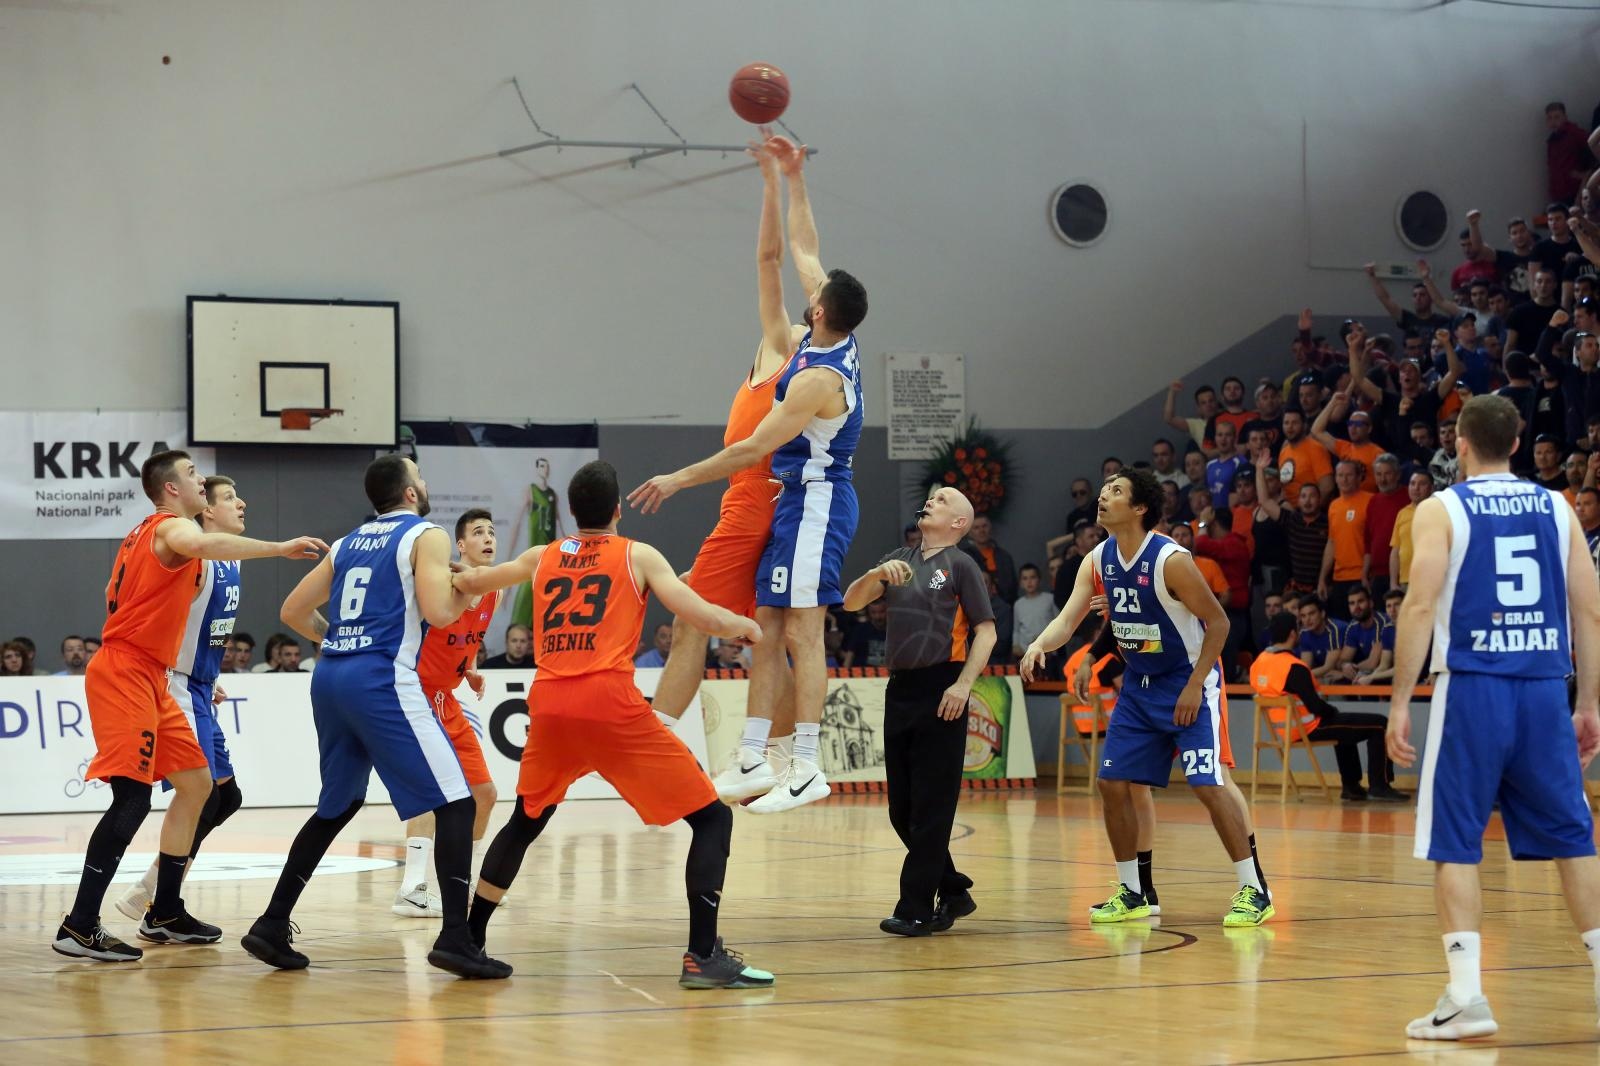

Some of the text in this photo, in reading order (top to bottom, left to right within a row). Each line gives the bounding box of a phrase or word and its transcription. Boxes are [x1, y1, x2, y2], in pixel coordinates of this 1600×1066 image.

[36, 489, 135, 504] Nacionalni park
[1465, 494, 1551, 516] VLADOVIĆ
[36, 506, 122, 517] National Park
[771, 567, 788, 593] 9
[1494, 534, 1541, 606] 5
[224, 585, 239, 611] 29
[340, 567, 372, 621] 6
[543, 574, 612, 633] 23
[1113, 587, 1141, 613] 23
[1504, 611, 1545, 625] GRAD
[1471, 628, 1559, 652] ZADAR
[456, 656, 468, 677] 4
[139, 730, 155, 759] 3
[1183, 749, 1214, 776] 23
